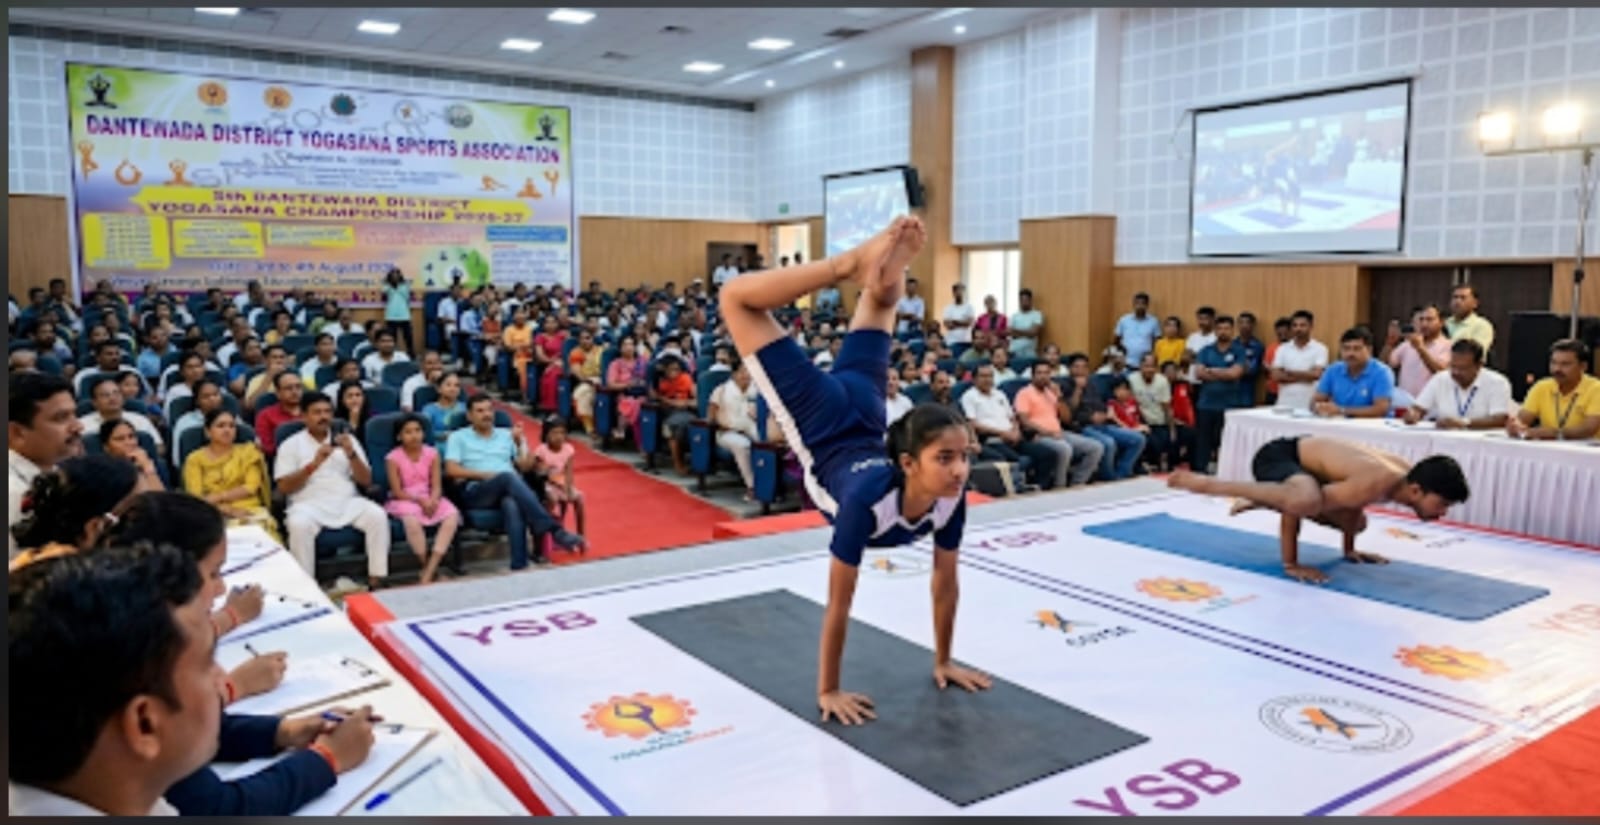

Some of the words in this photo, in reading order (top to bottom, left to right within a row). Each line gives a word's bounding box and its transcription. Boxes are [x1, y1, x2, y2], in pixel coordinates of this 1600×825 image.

[86, 113, 207, 141] DANTEWADA
[212, 122, 295, 148] DISTRICT
[299, 129, 392, 153] YOGASANA
[396, 136, 458, 158] SPORTS
[461, 141, 560, 164] ASSOCIATION
[148, 202, 276, 217] YOGASANA
[284, 205, 446, 221] CHAMPIONSHIP
[253, 192, 379, 208] DANTEWADA
[386, 196, 471, 210] DISTRICT
[451, 610, 597, 645] YSB
[1072, 757, 1242, 816] YSB
